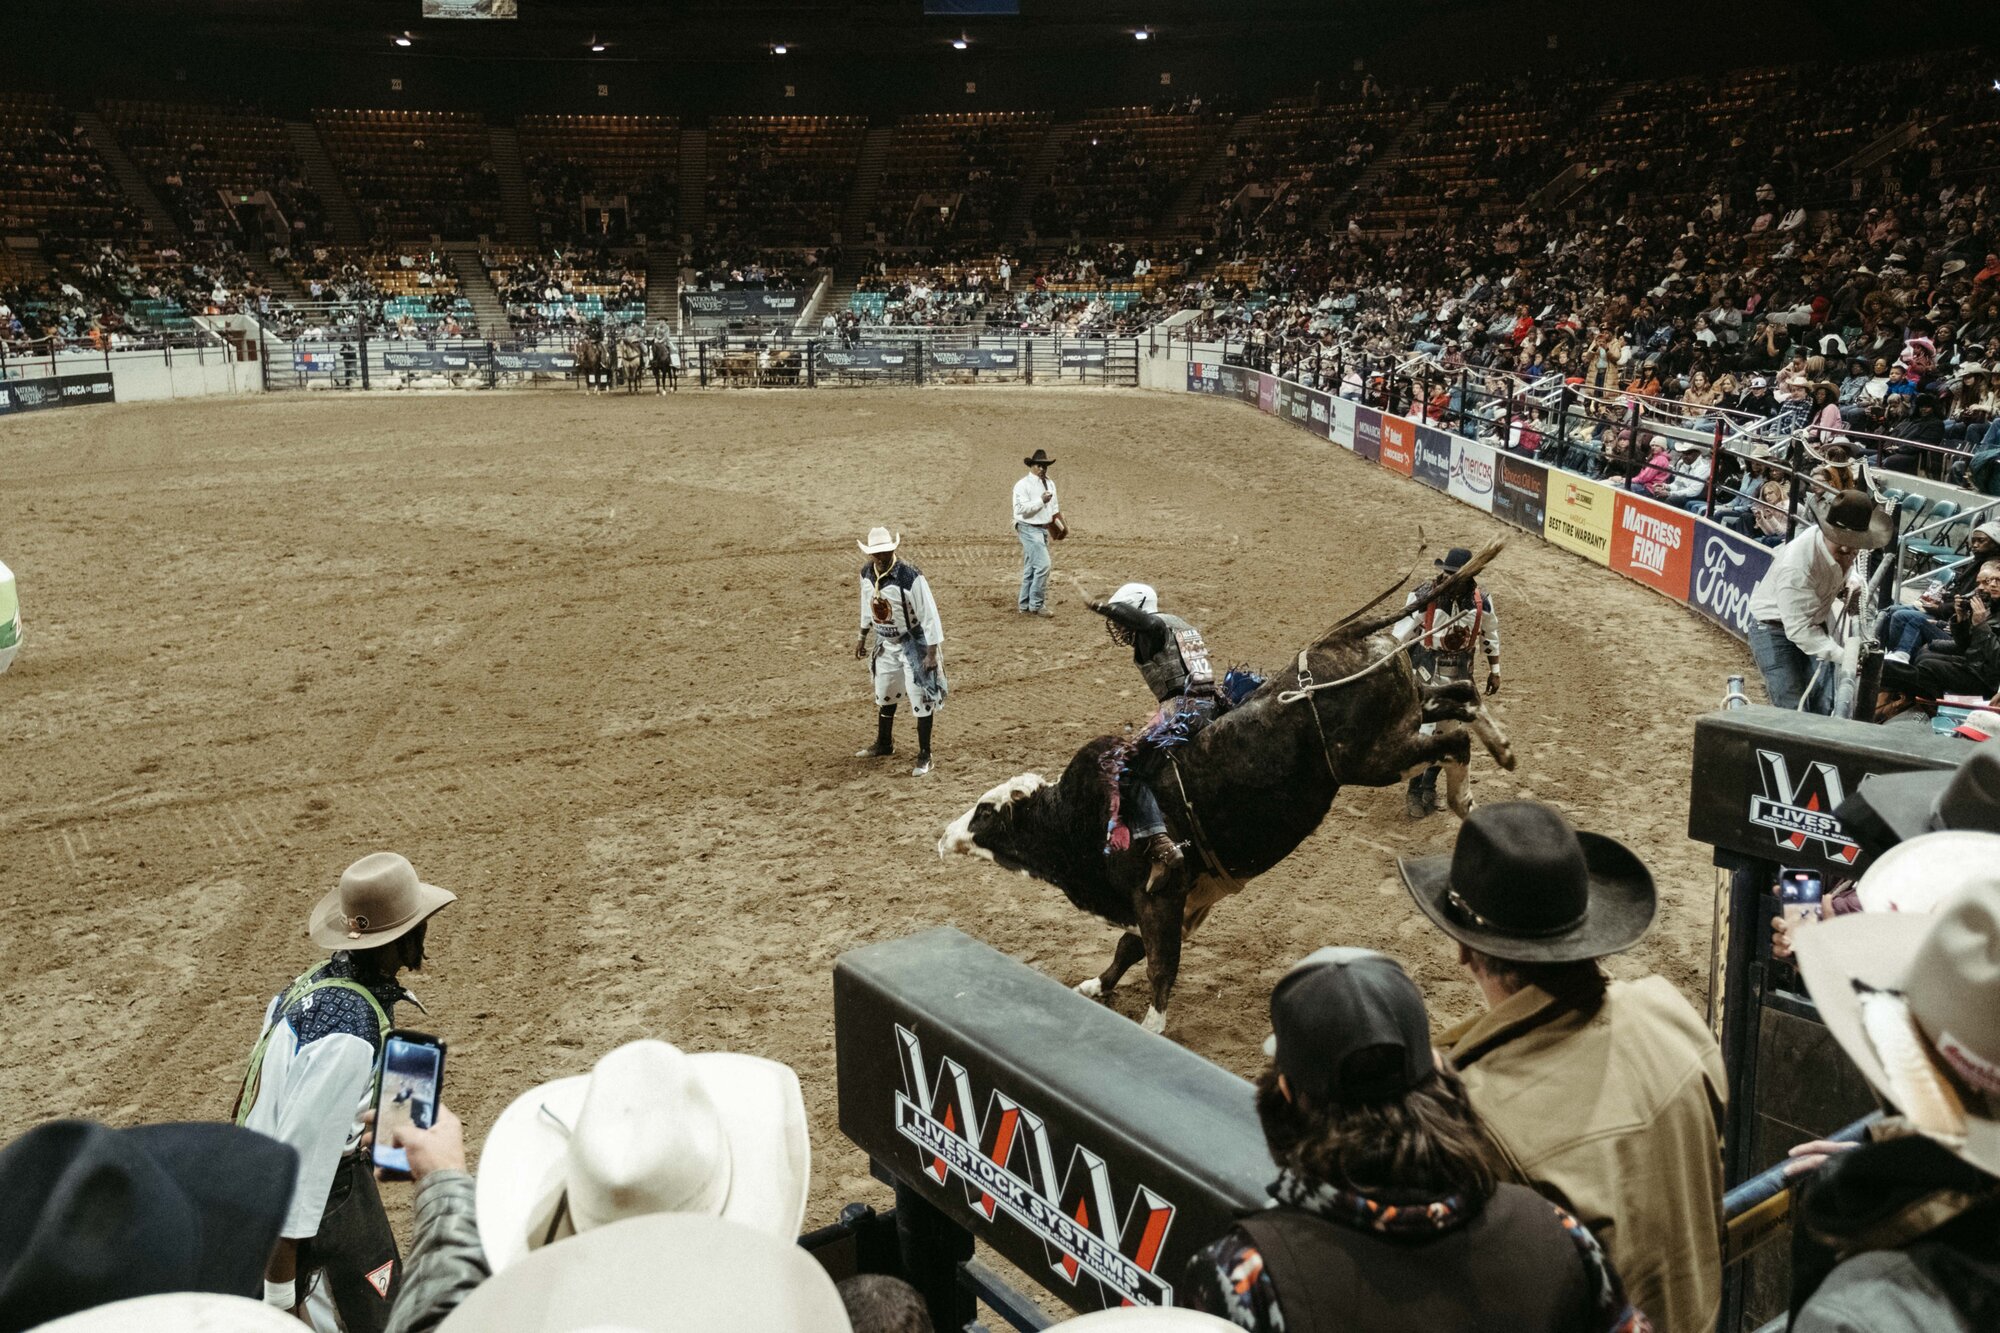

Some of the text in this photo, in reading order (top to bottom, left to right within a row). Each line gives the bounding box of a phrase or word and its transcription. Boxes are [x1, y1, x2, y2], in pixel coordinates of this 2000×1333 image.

[1360, 421, 1381, 439] MONARCH
[1423, 448, 1449, 471] Alpine Bank
[1549, 516, 1607, 550] BEST TIRE WARRANTY
[1622, 504, 1682, 550] MATTRESS
[1631, 535, 1667, 571] FIRM
[914, 1111, 1140, 1290] LIVESTOCK SYSTEMS
[1081, 1252, 1135, 1300] THOMAS,
